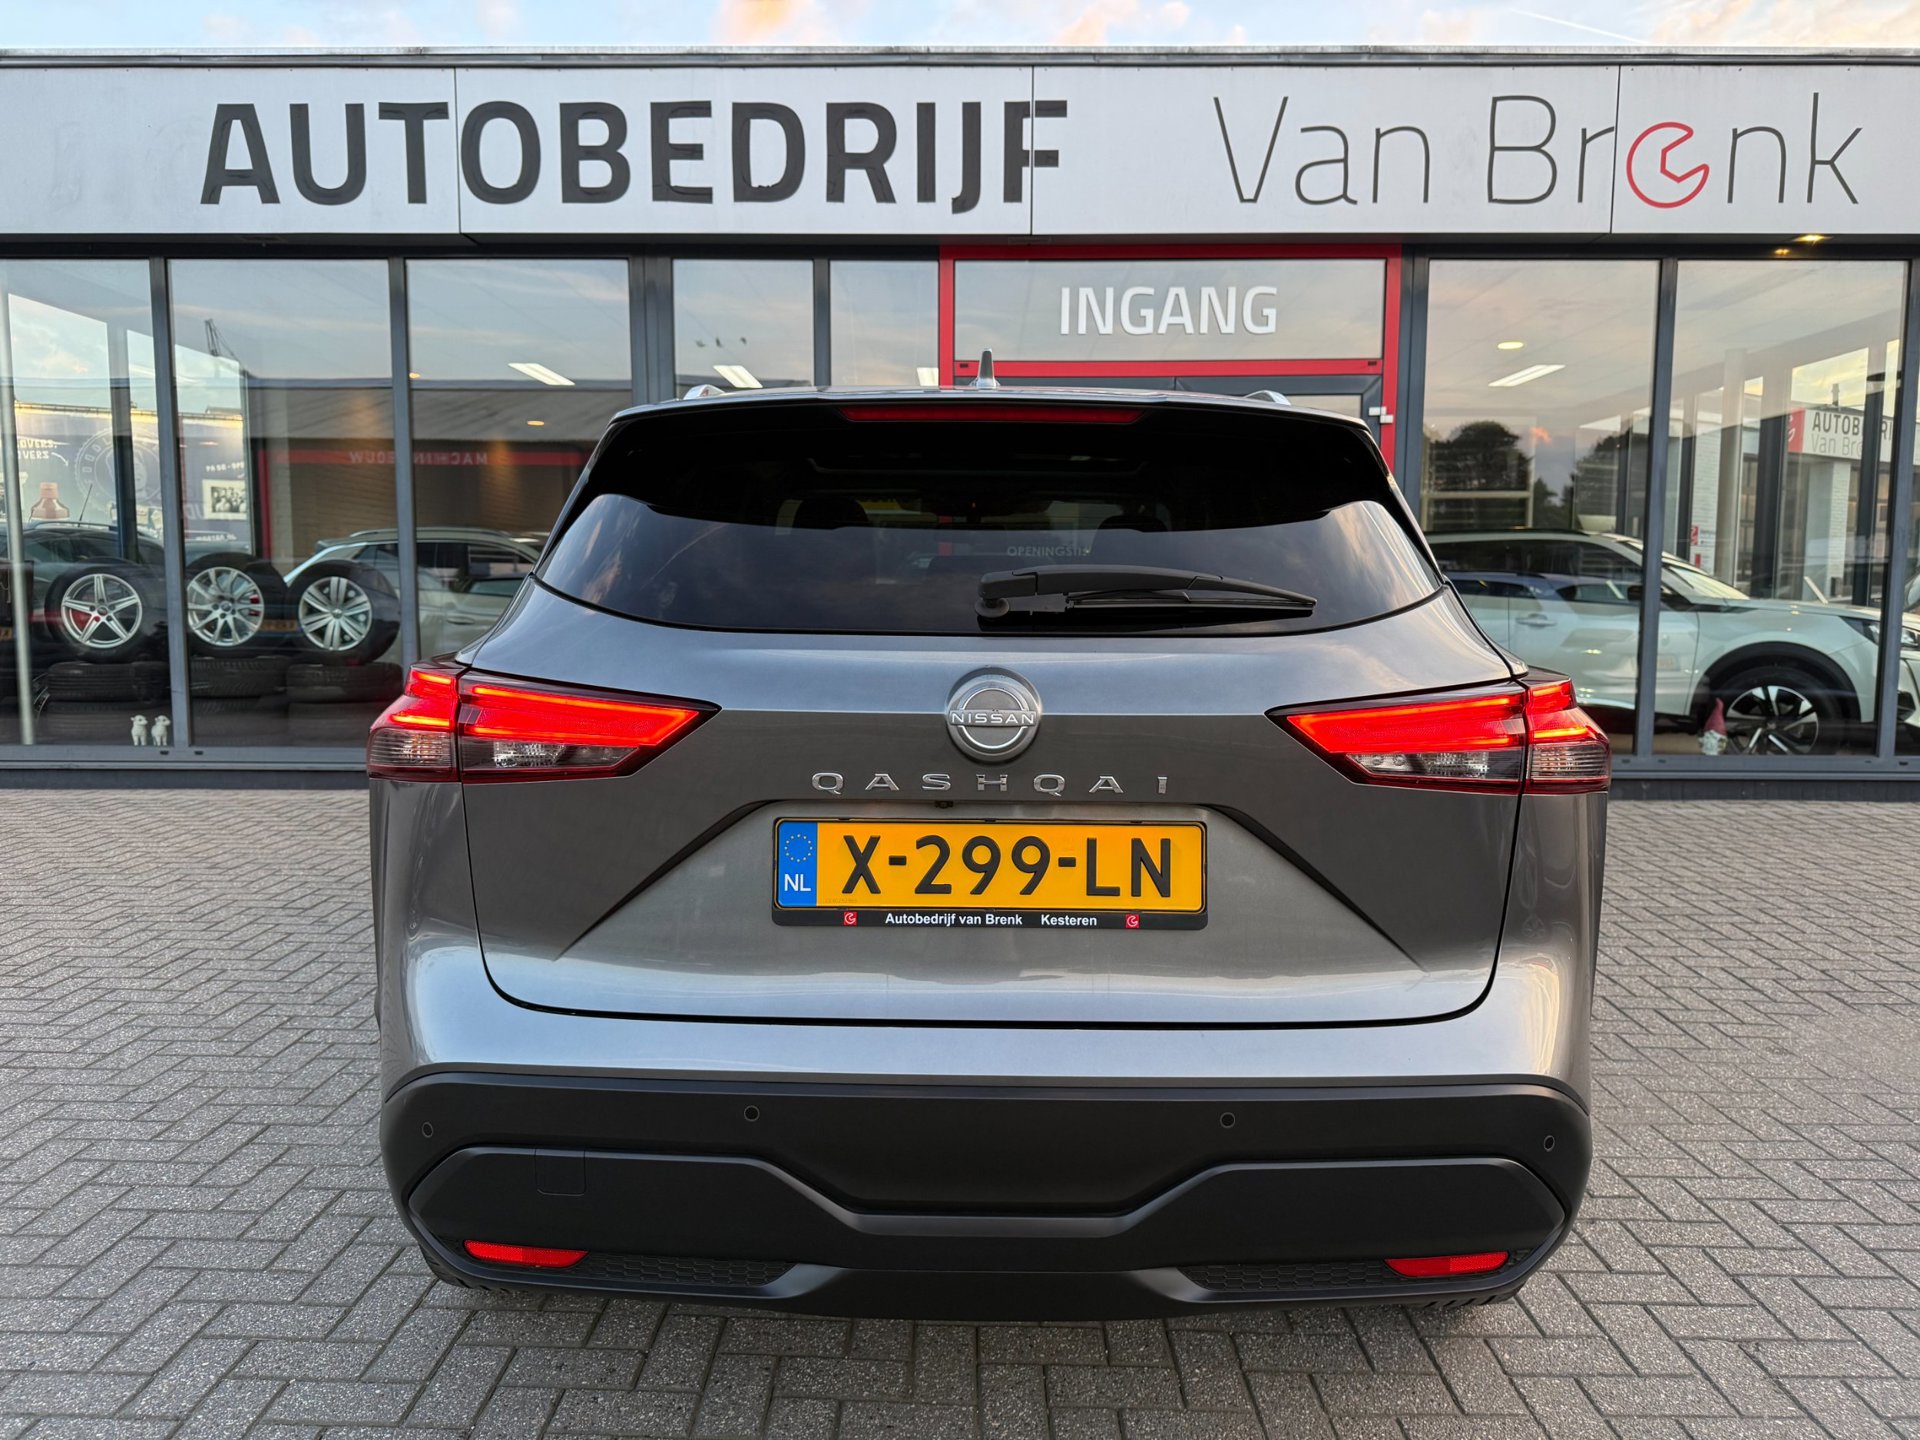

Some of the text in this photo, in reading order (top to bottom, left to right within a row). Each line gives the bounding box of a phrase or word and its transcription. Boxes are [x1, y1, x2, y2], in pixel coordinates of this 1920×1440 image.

[200, 92, 1863, 214] AUTOBEDRIJF Van Brenk
[1059, 286, 1278, 335] INGANG
[1811, 433, 1837, 454] Van
[951, 711, 1035, 726] NISSAN
[811, 771, 1169, 797] QASHQAI
[841, 834, 1171, 898] X-299-LN
[783, 873, 812, 892] NL
[884, 912, 1098, 927] Autobedrijf van Brenk Kesteren
